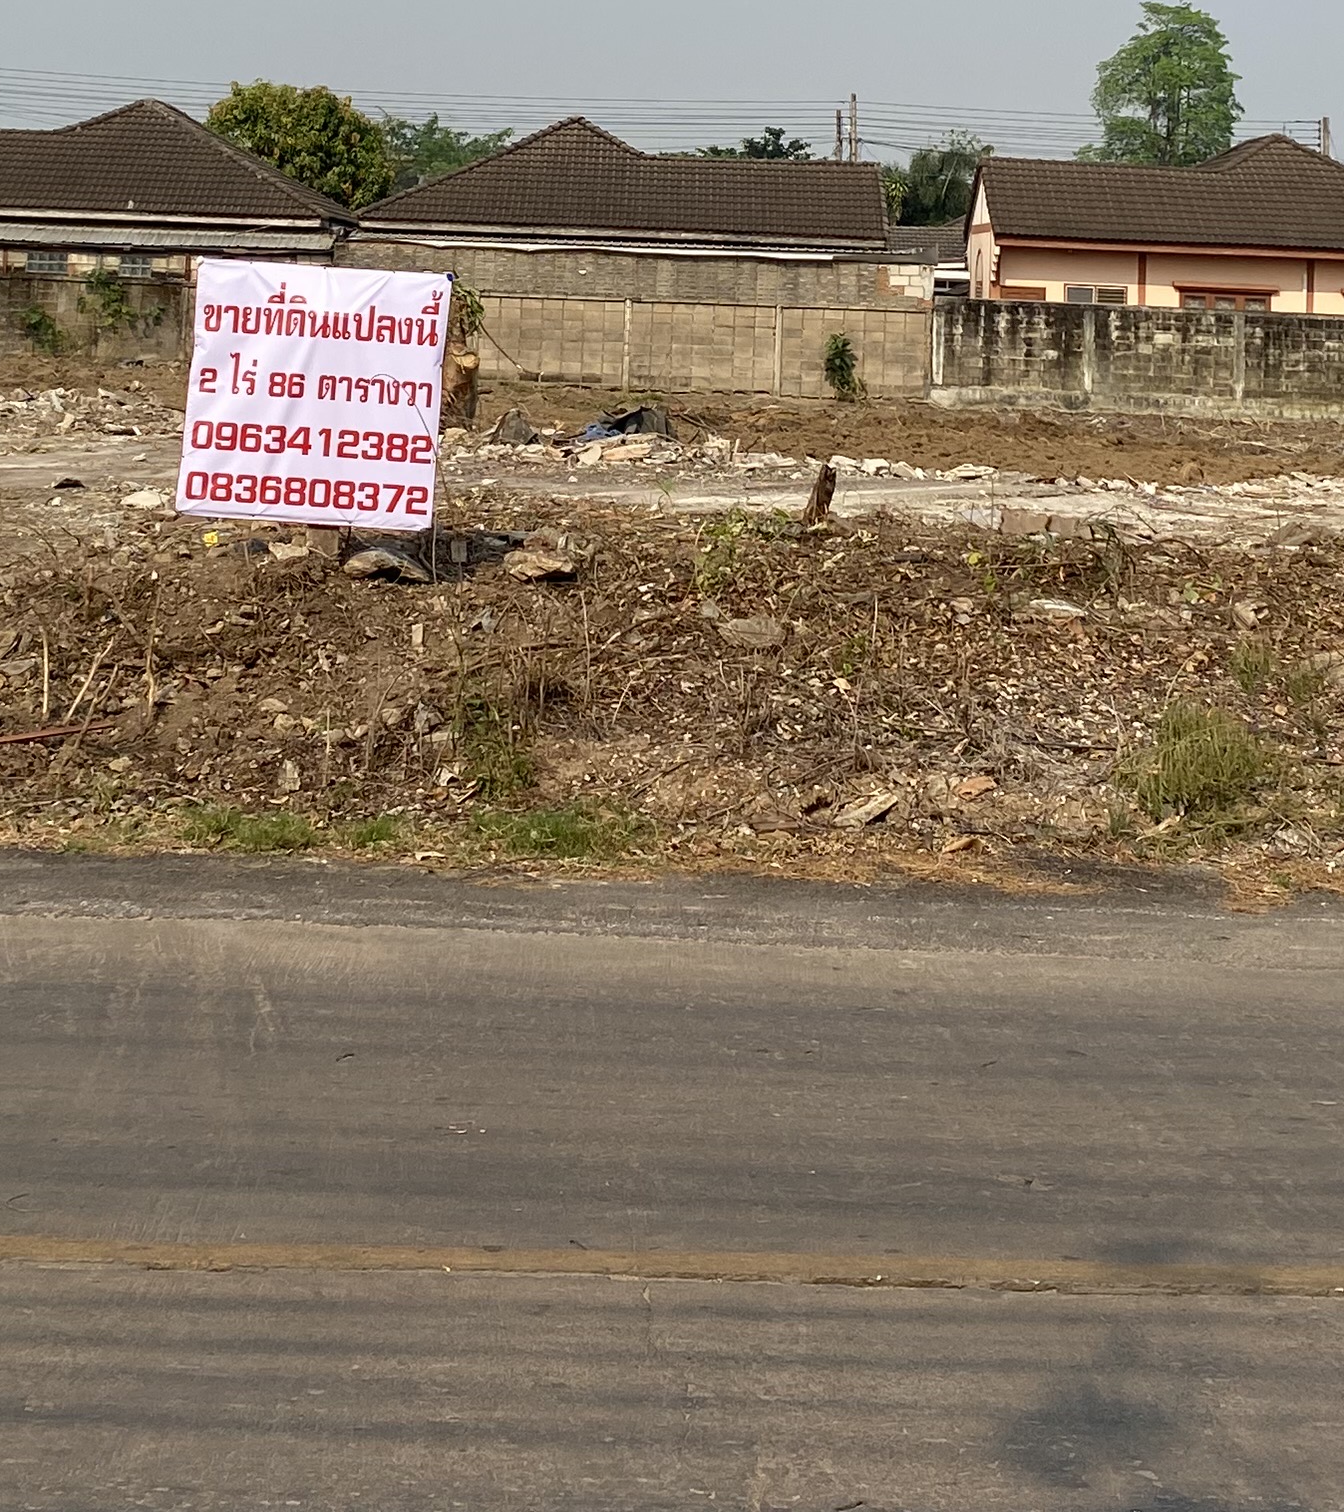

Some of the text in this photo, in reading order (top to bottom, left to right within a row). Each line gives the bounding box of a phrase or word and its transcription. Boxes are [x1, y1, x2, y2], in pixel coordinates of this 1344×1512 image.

[203, 282, 443, 347] ขายที่ดินแปลงนี้
[199, 352, 434, 408] 2 ไร่ 86 ตารางวา
[190, 420, 433, 465] 0963412382
[184, 471, 429, 516] 0836808372
